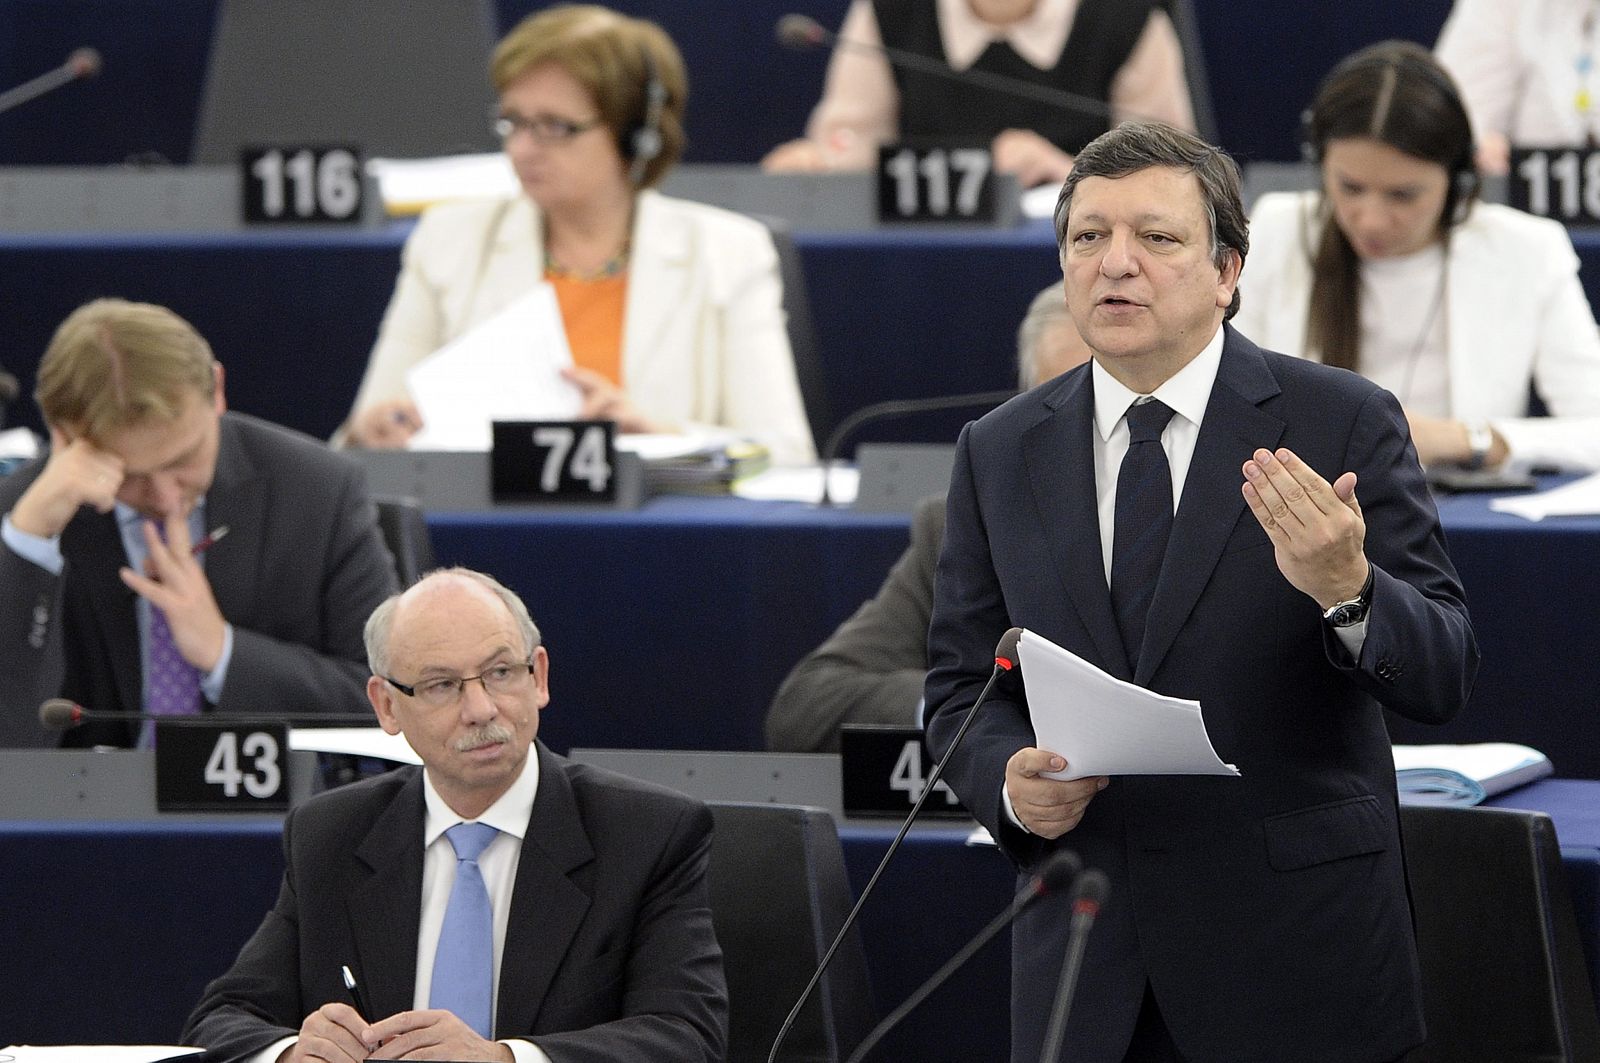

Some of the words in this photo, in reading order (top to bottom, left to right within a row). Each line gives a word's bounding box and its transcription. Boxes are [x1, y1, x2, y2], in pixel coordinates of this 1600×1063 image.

[252, 149, 359, 218] 116
[885, 148, 991, 217] 117
[532, 426, 612, 492] 74
[204, 731, 281, 799] 43
